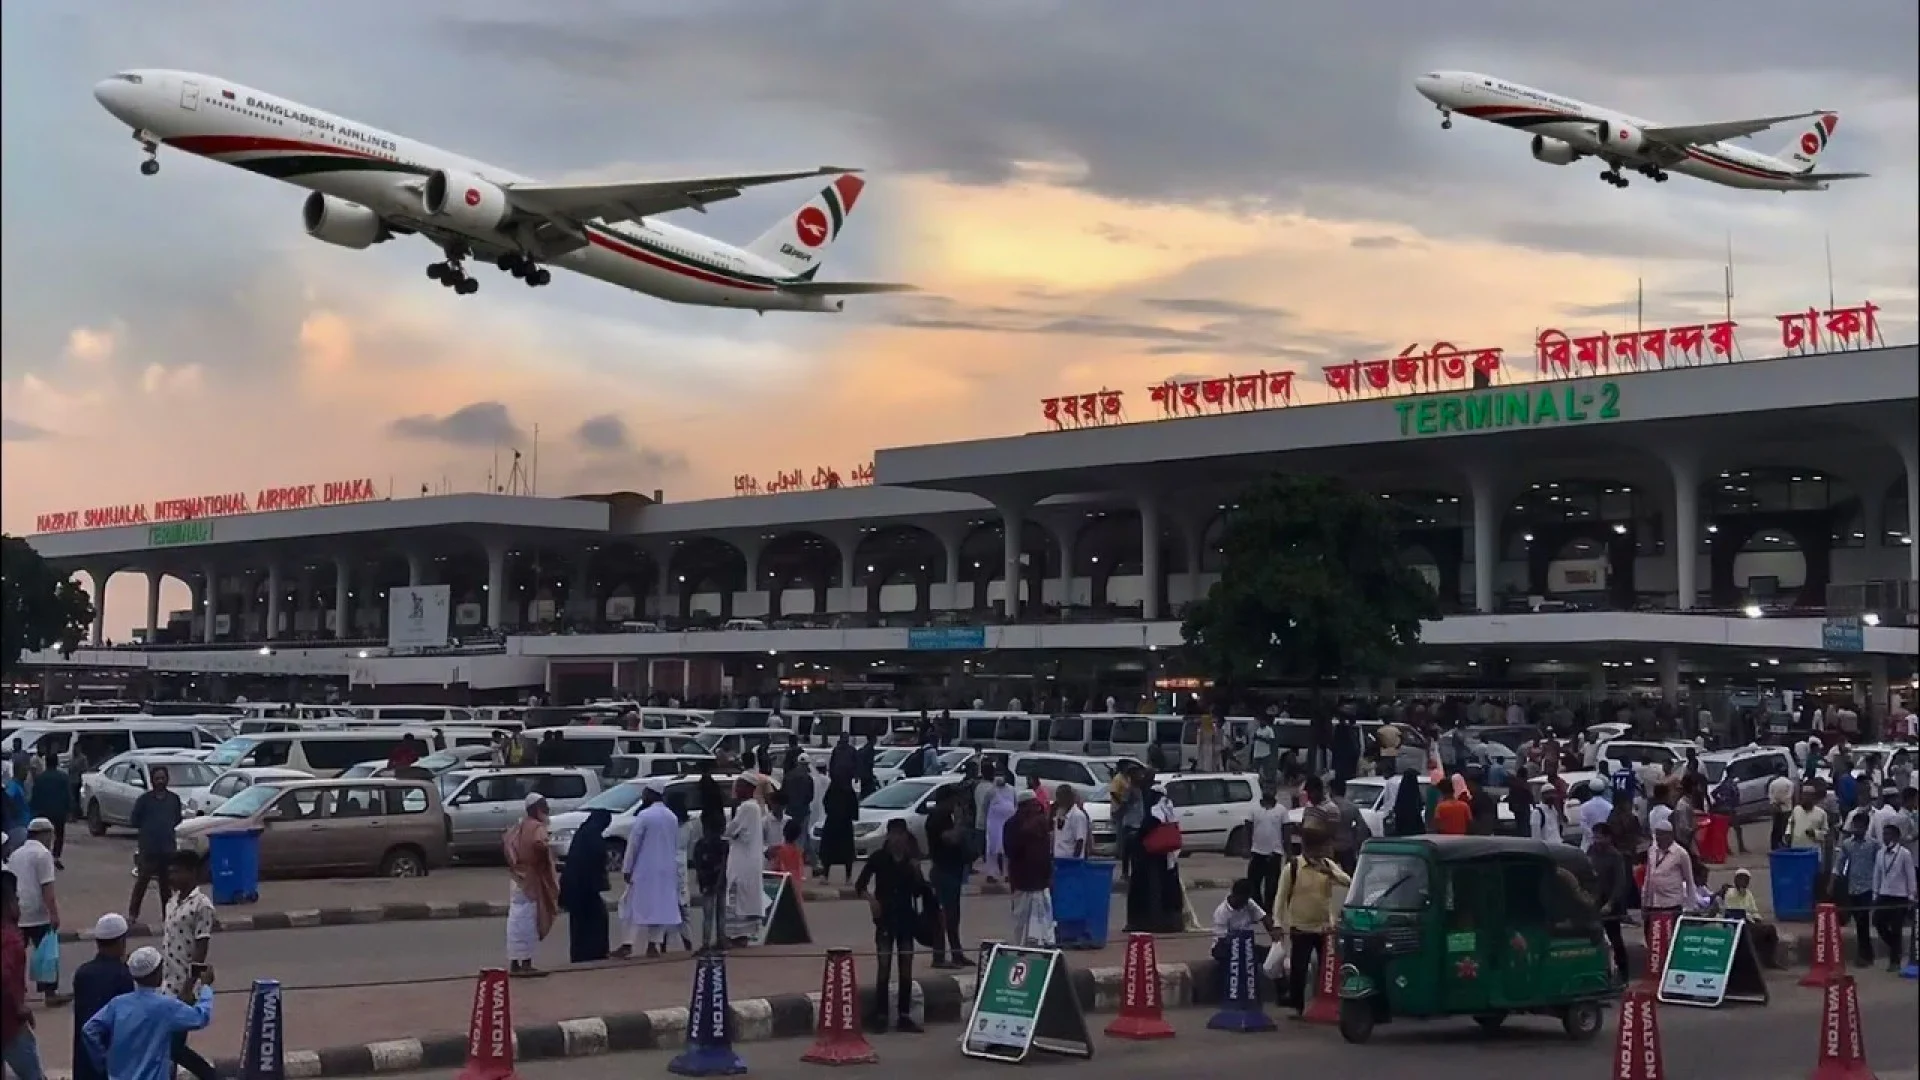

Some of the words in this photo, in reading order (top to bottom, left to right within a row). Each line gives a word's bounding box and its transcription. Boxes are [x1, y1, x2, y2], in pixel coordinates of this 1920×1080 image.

[246, 97, 335, 132] BANGLADESH
[339, 126, 397, 151] AIRLINES
[1147, 370, 1295, 412] শাহজালাল
[1536, 321, 1738, 373] বিমানবন্দর
[1776, 301, 1880, 348] ঢাকা
[155, 490, 247, 519] INTERNATIONAL
[257, 485, 315, 510] AIRPORT
[324, 479, 374, 503] DHAKA
[691, 967, 706, 1037] WALTON
[712, 966, 723, 1036] WALTON
[824, 961, 834, 1026] WALTON
[841, 960, 852, 1029] WALTON
[1128, 942, 1138, 1005] WALTON
[1143, 942, 1154, 1005] WALTON
[1229, 937, 1239, 999] WALTON
[260, 992, 277, 1071] WALTON
[470, 981, 486, 1056] WALTON
[492, 981, 504, 1056] WALTON
[1620, 1001, 1633, 1078] WALTON
[1641, 1001, 1656, 1078] WALTON
[1828, 985, 1839, 1056] WALTON
